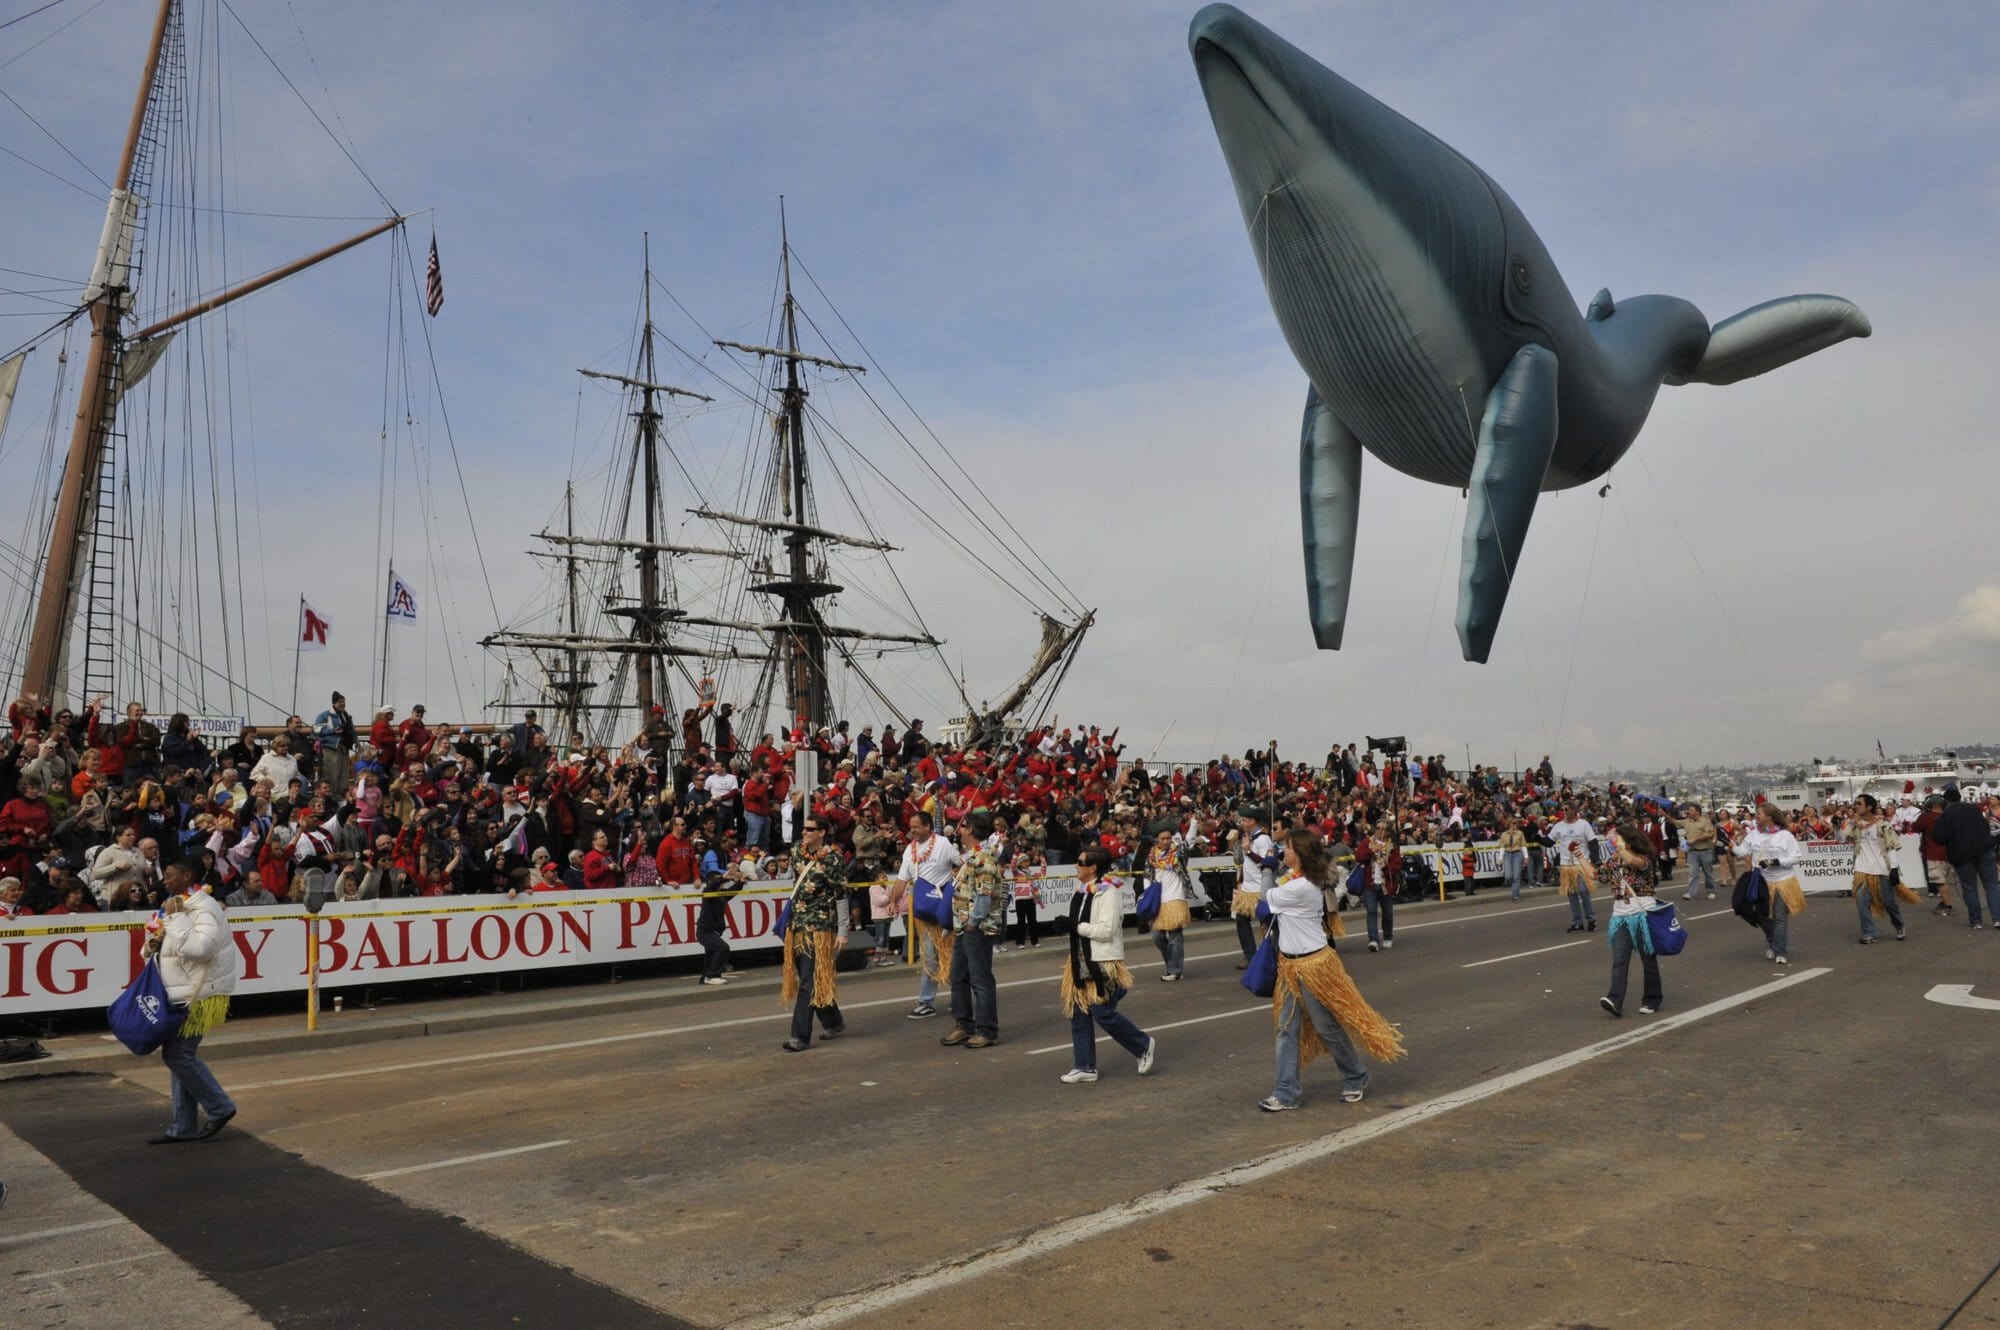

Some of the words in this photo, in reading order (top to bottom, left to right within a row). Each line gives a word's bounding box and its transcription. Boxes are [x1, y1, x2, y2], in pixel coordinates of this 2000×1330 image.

[303, 609, 328, 646] N
[202, 719, 236, 732] TODAY!
[1799, 860, 1828, 868] PRIDE
[1830, 859, 1844, 867] OF
[47, 926, 86, 935] CAUTION
[108, 923, 145, 932] CAUTION
[299, 909, 595, 976] BALLOON
